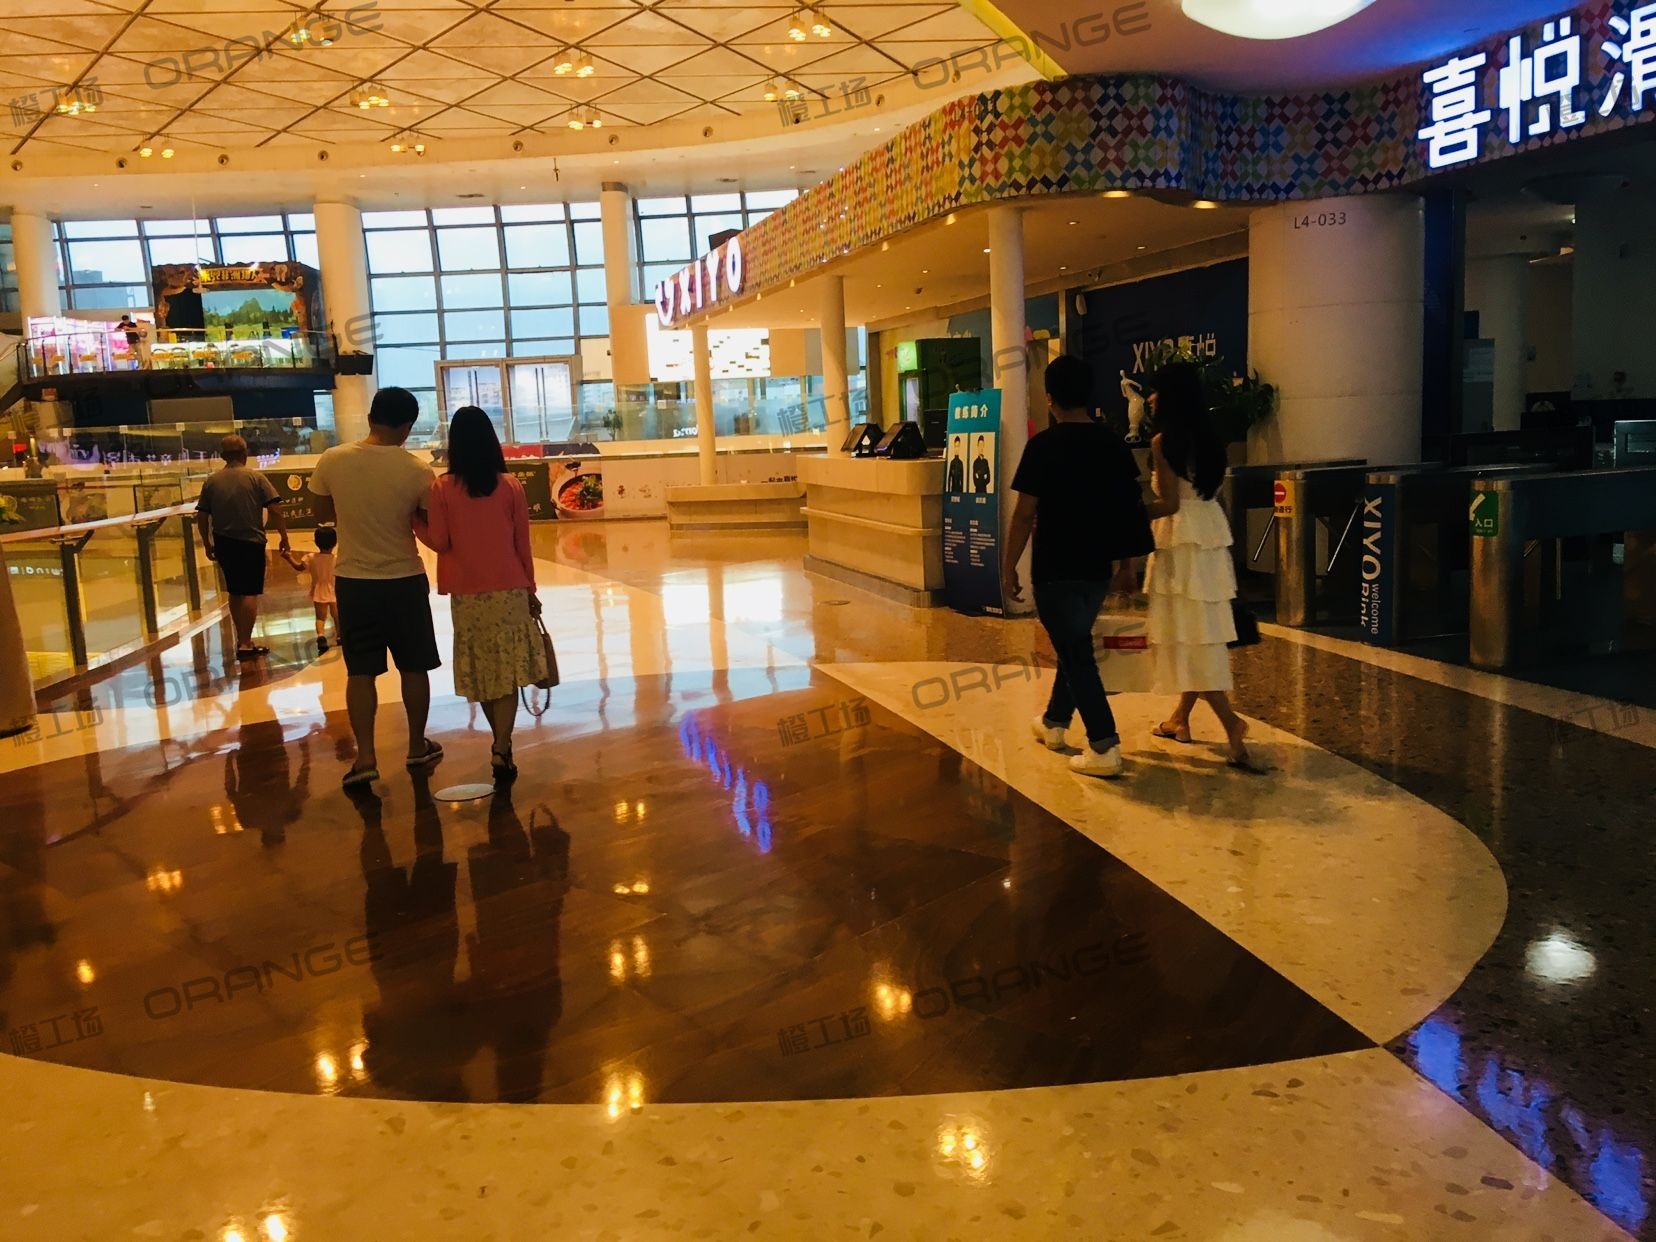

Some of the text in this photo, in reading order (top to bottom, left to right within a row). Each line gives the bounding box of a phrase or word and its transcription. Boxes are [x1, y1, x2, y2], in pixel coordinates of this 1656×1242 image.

[1294, 211, 1347, 229] L4-033
[1361, 496, 1383, 581] XIYO
[1474, 517, 1494, 528] 入口
[1370, 583, 1381, 636] welcome
